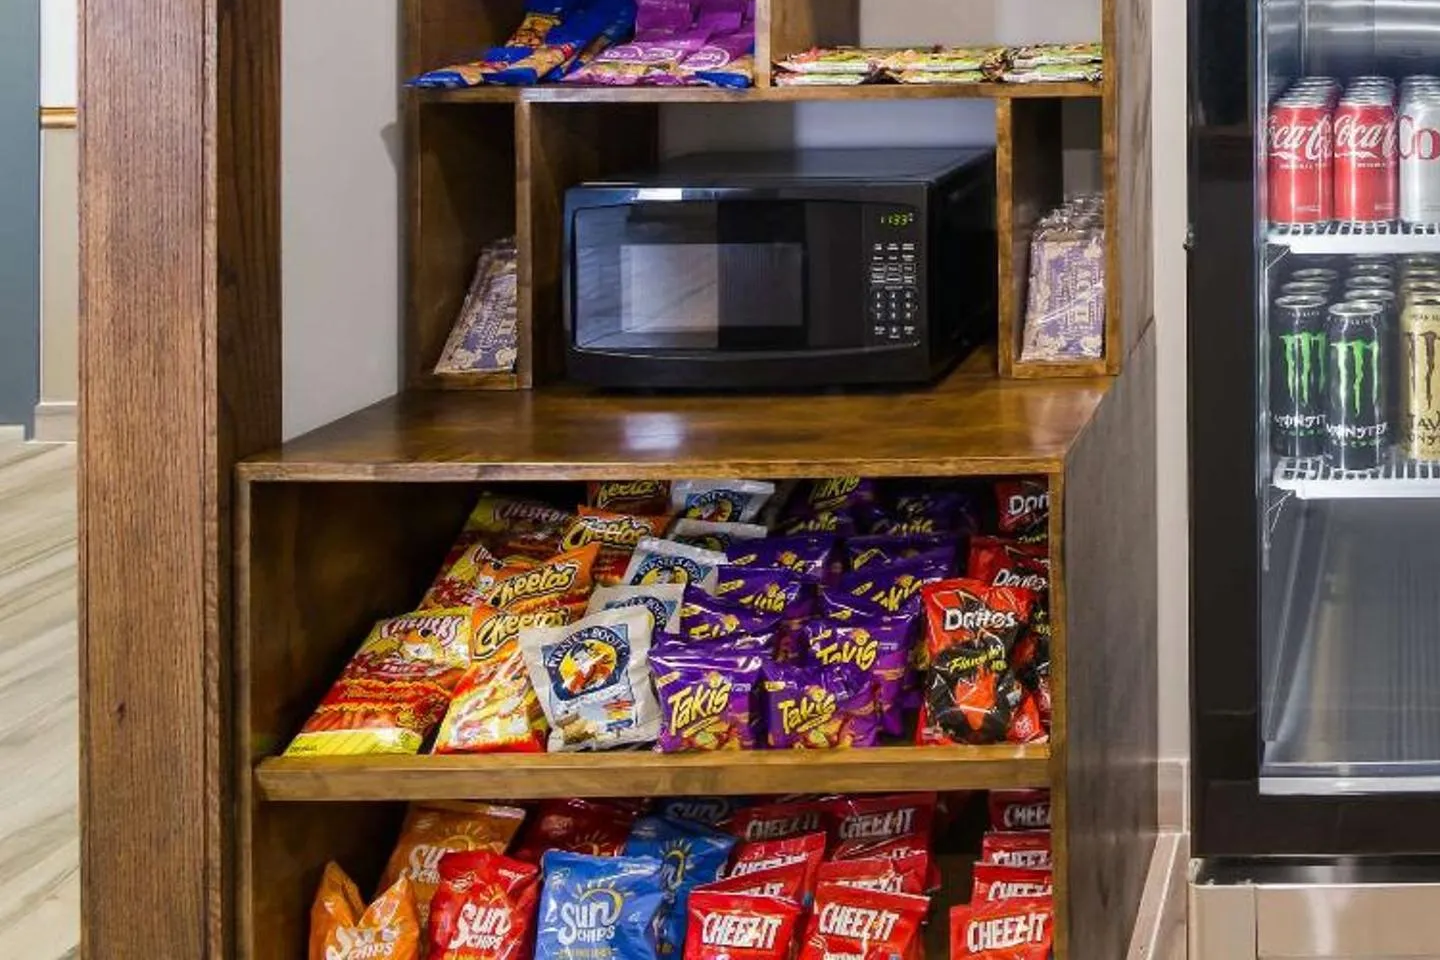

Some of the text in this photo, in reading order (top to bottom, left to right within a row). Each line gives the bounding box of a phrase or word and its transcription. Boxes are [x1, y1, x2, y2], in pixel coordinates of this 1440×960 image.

[944, 608, 1017, 632] Doritos
[668, 681, 732, 737] Takis
[778, 693, 837, 735] Takis
[838, 809, 916, 839] CHEEZ-IT
[702, 912, 783, 950] CHEEZ-IT
[818, 902, 900, 941] CHEEZ-IT
[966, 912, 1049, 953] CHEEZ-IT
